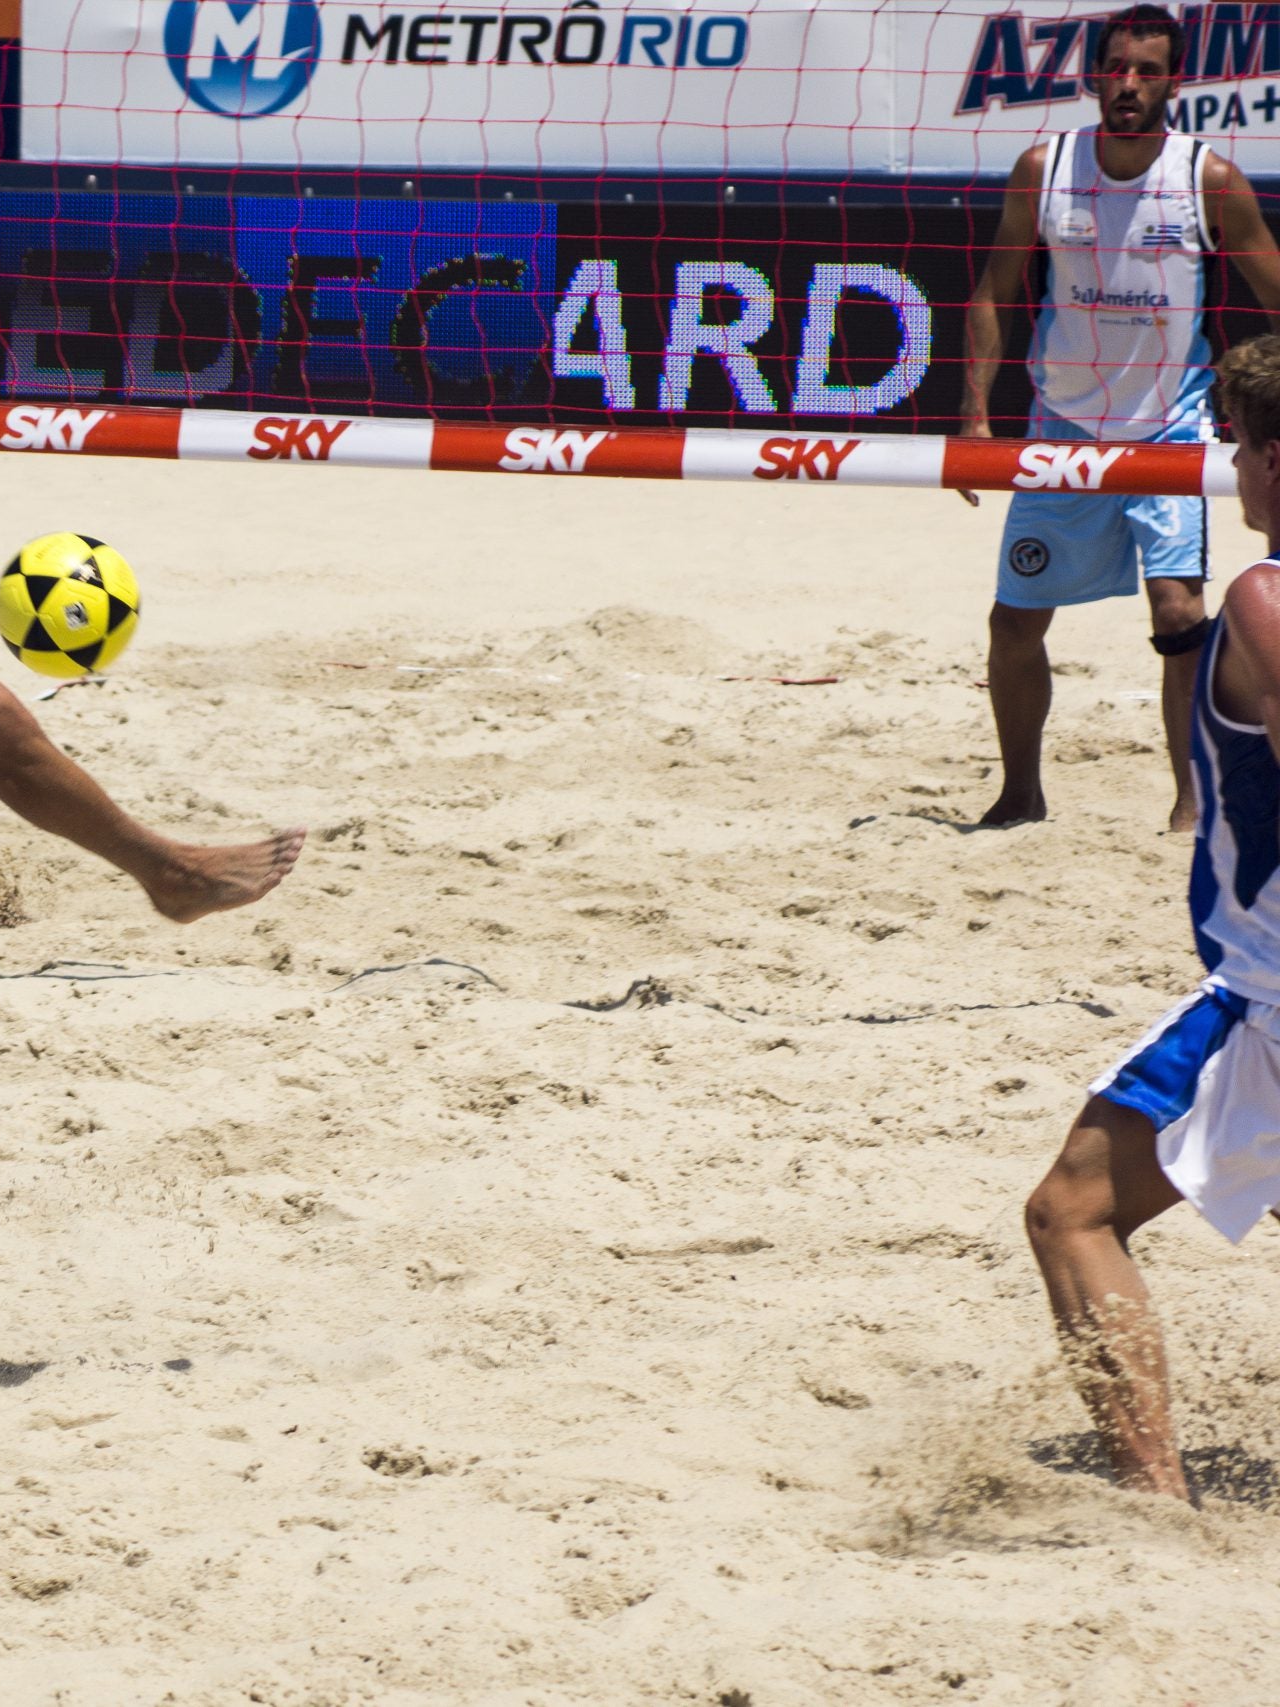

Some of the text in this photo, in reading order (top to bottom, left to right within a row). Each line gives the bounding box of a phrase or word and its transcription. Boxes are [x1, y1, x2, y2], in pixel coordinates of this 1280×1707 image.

[953, 2, 1280, 115] AZIM
[1166, 84, 1280, 134] MPA+
[0, 405, 107, 451] SKY
[247, 417, 354, 460] SKY
[499, 427, 609, 471] SKY
[752, 437, 864, 480] SKY
[1012, 443, 1127, 489] SKY
